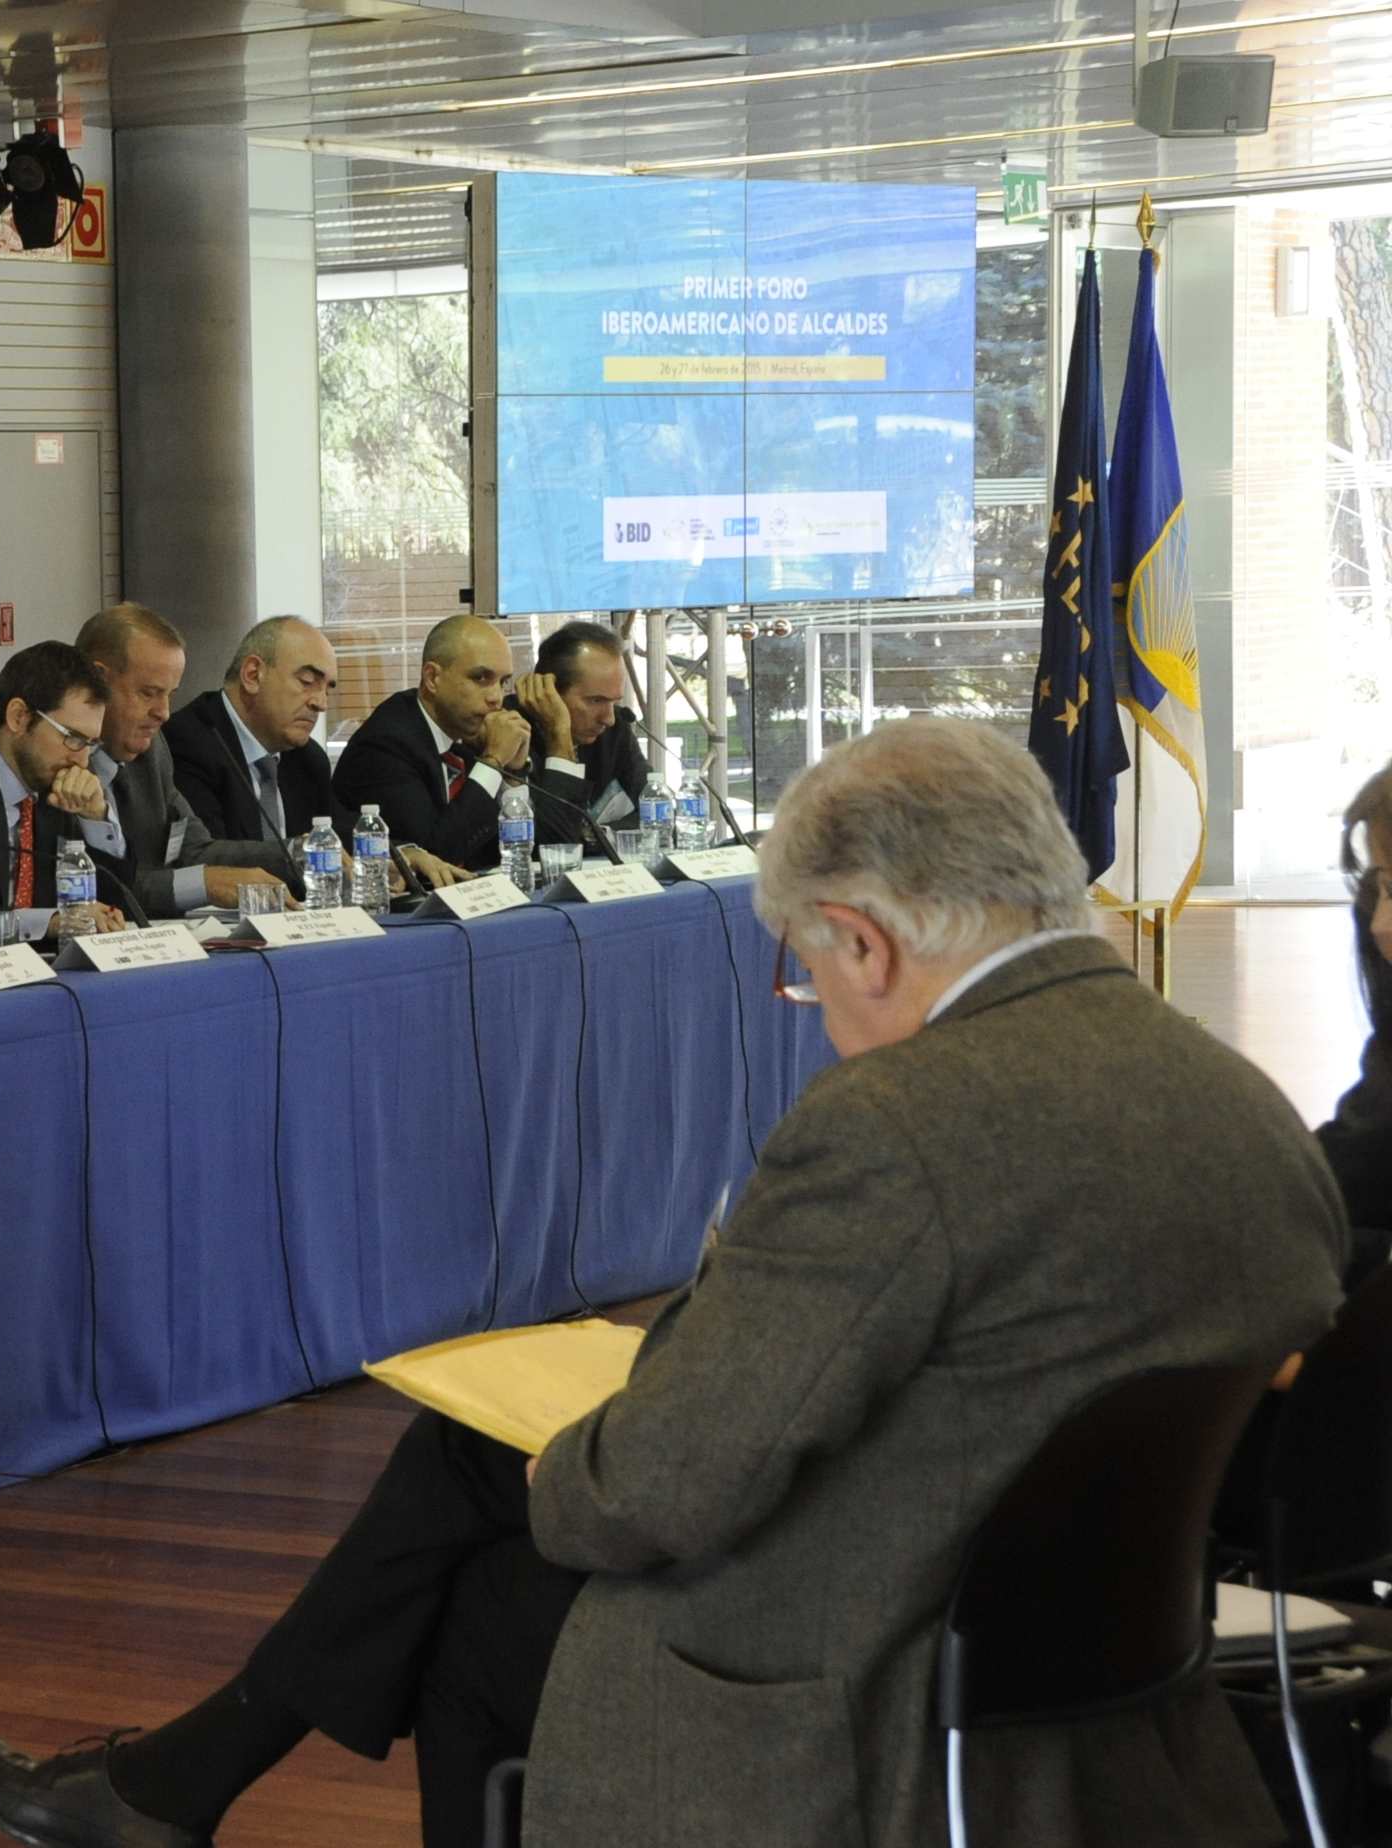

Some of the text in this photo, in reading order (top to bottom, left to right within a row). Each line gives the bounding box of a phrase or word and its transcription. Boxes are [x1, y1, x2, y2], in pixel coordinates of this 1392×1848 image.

[683, 276, 808, 300] PRIMER FORO
[601, 311, 889, 336] IBEROAMERICANO DE ALCALDES
[625, 522, 651, 543] BID
